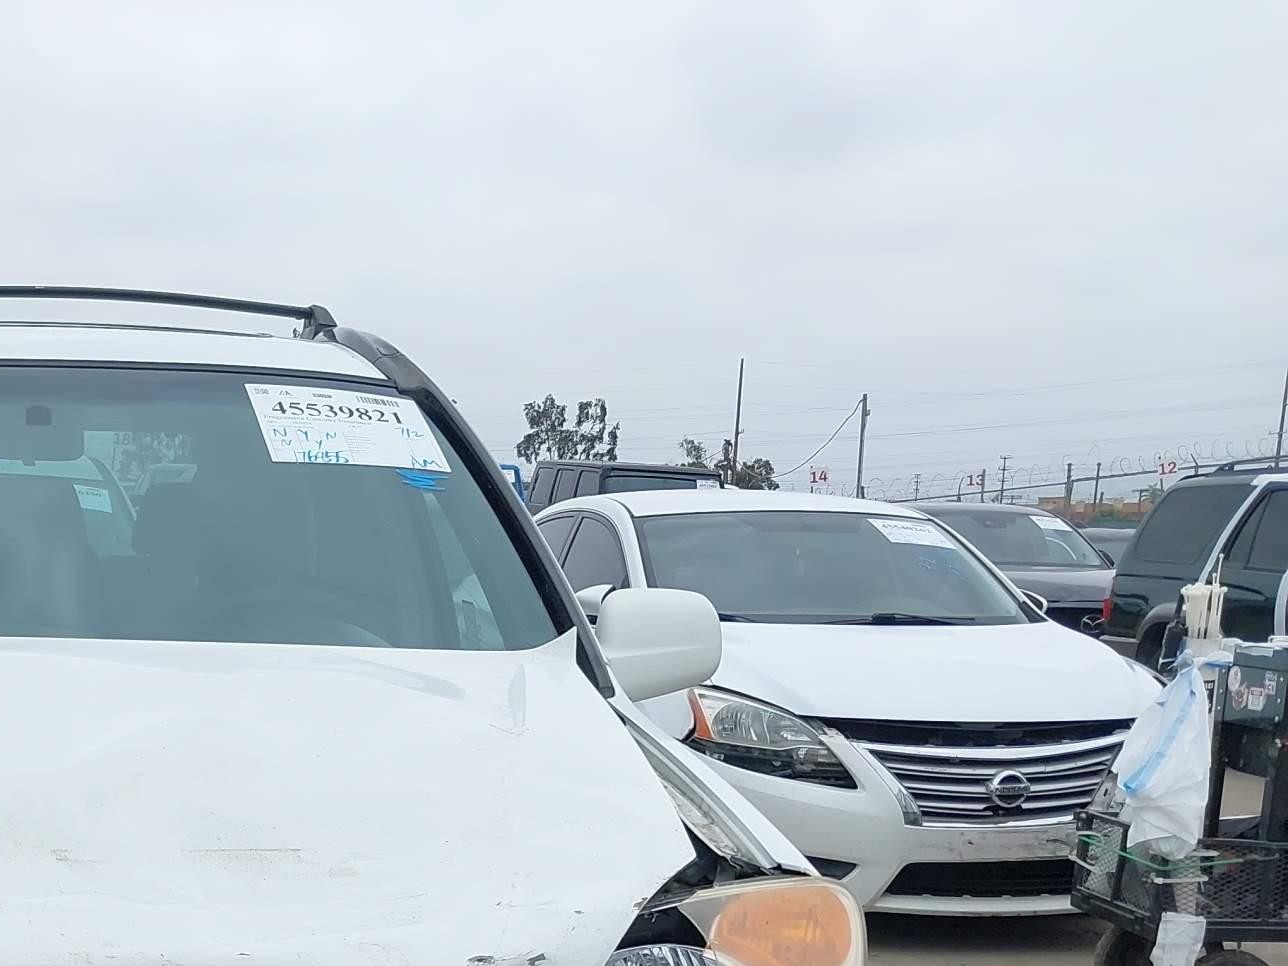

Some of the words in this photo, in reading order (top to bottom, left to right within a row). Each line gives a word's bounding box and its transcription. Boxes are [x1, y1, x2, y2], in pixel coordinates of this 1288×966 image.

[271, 400, 403, 425] 45539821
[273, 428, 288, 438] N
[1158, 461, 1178, 476] 12
[809, 470, 829, 484] 14
[966, 474, 985, 487] 13
